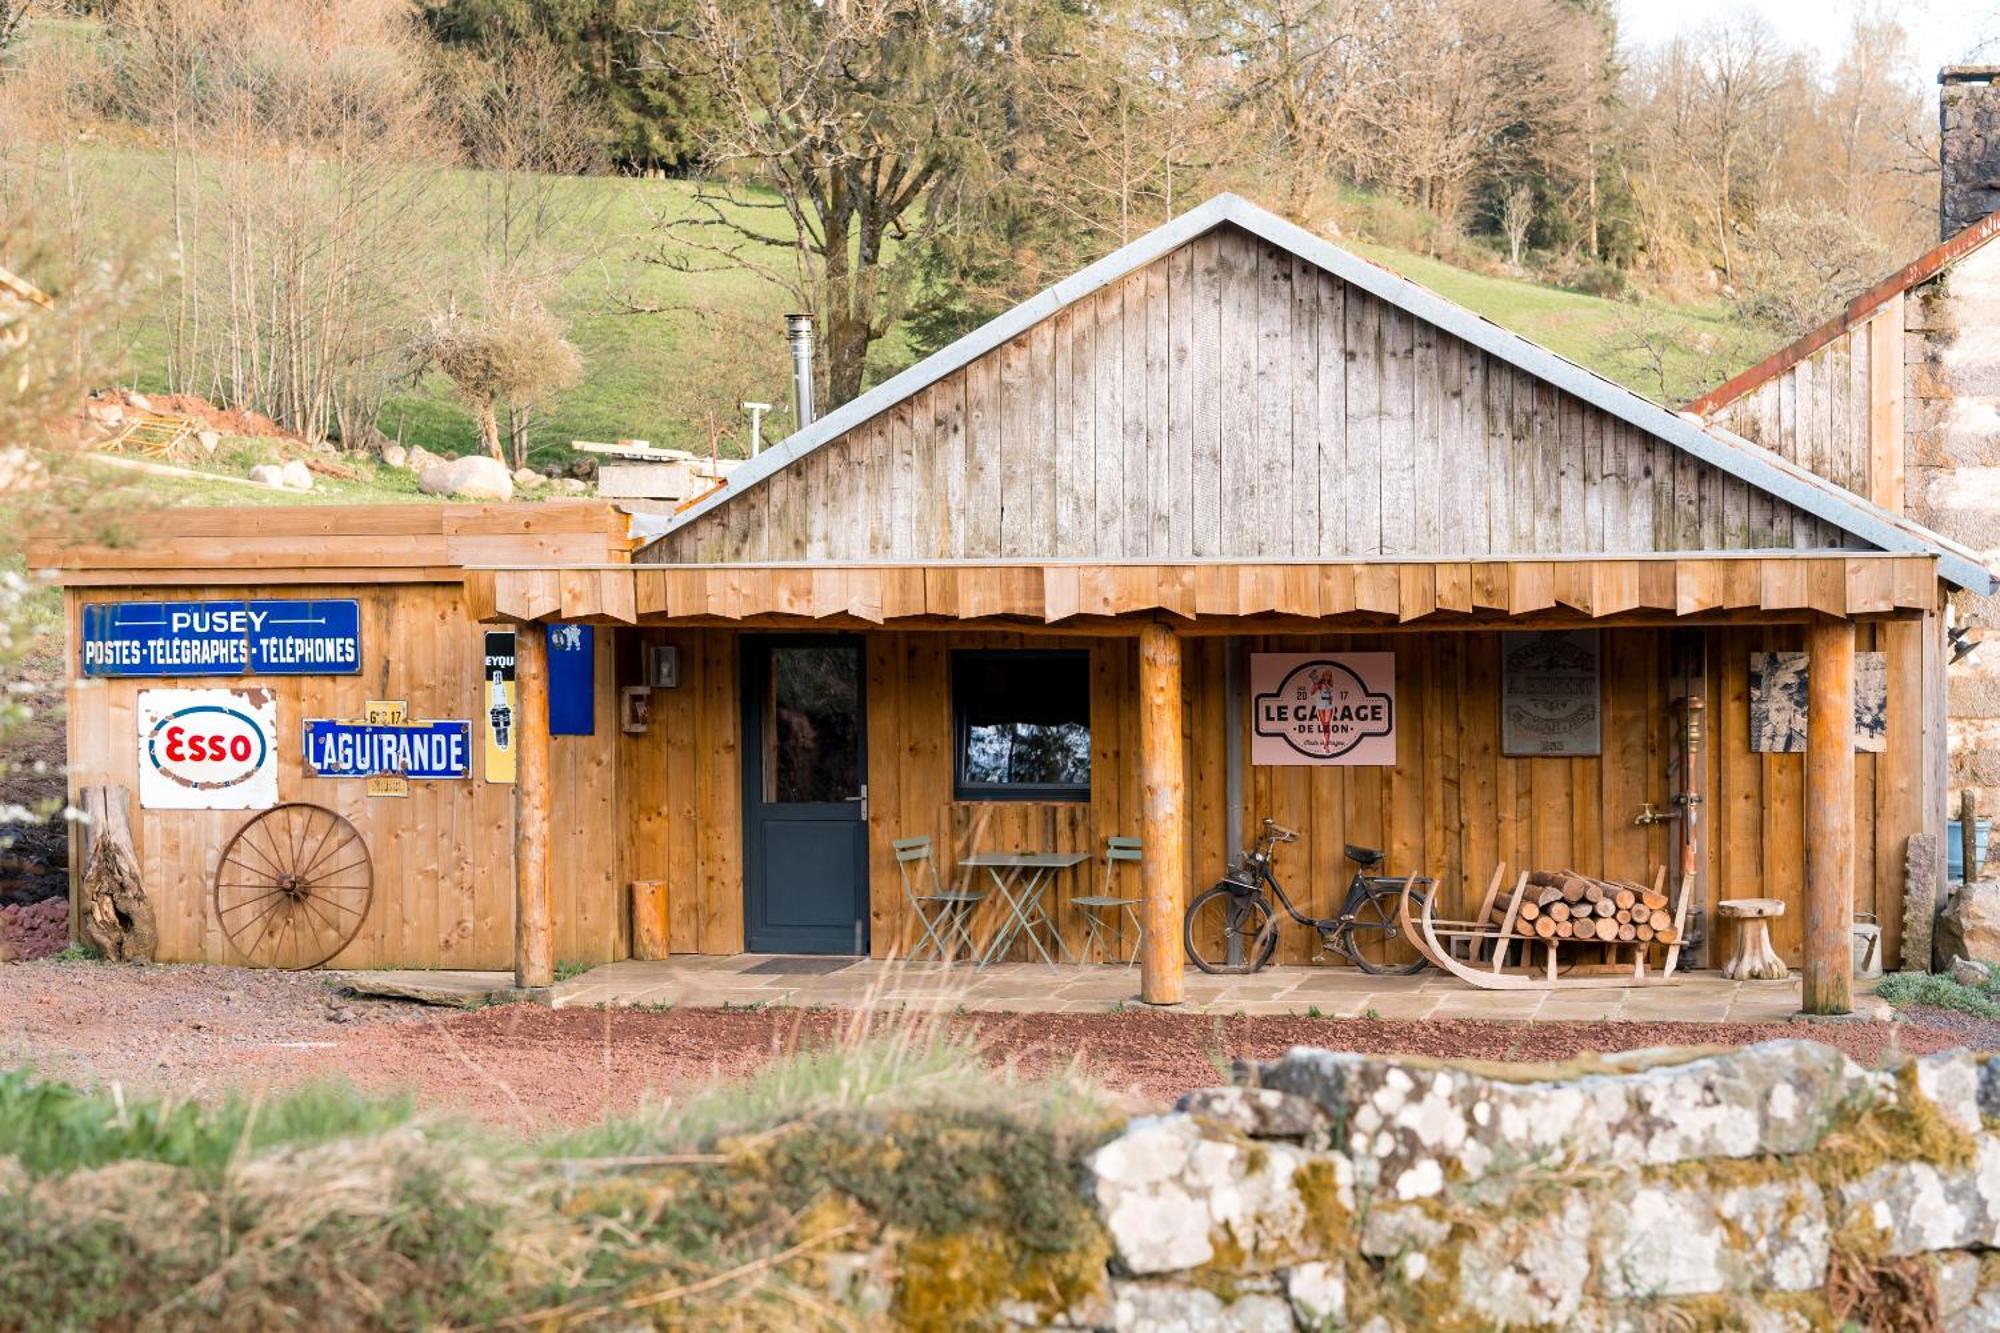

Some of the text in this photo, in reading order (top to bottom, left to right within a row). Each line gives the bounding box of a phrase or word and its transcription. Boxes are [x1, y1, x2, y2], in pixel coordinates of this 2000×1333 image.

[172, 611, 268, 633] PUSEY
[260, 635, 355, 664] TÉLÉPHONES
[1297, 691, 1349, 700] 20 17
[391, 711, 401, 725] 17
[1265, 705, 1288, 721] LE
[1298, 724, 1314, 733] DE
[308, 733, 464, 771] LAGUIRANDE
